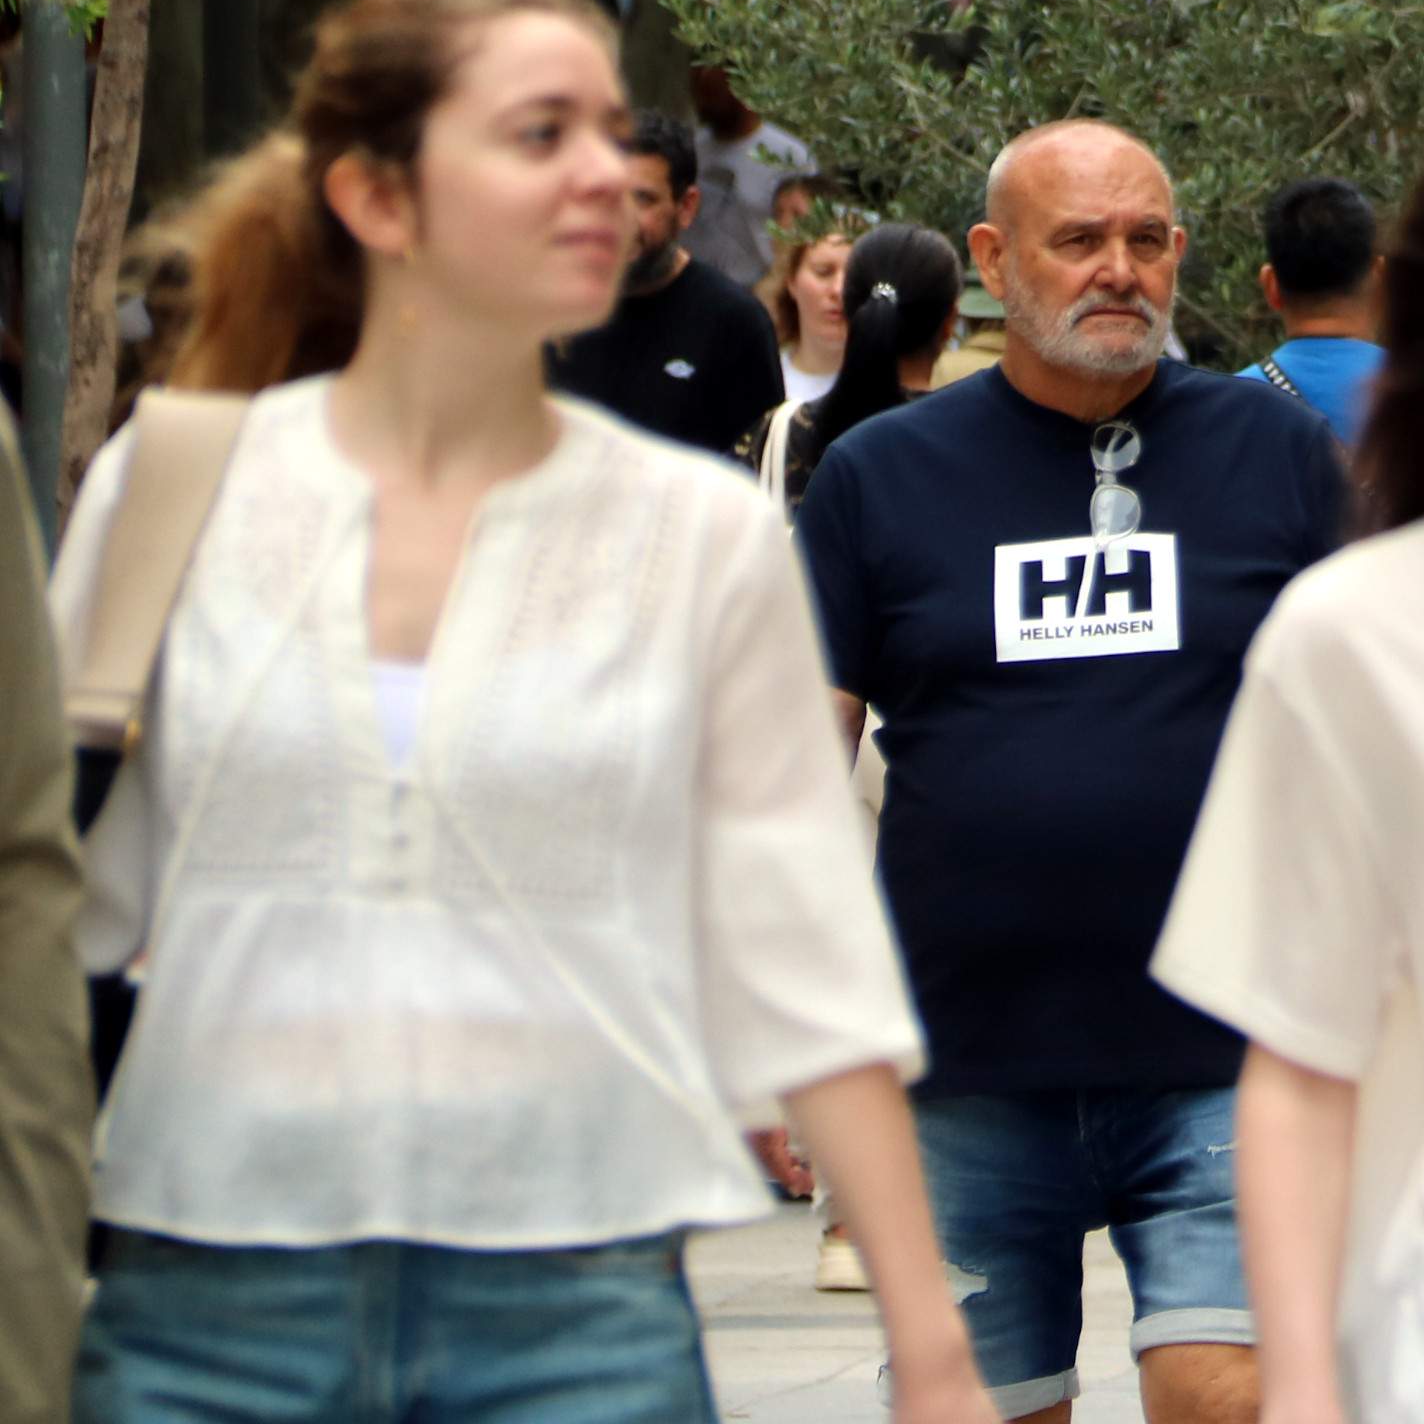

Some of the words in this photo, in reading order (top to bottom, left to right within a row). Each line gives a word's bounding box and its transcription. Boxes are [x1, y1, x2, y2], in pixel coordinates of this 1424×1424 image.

[1019, 549, 1152, 620] HH
[1019, 625, 1074, 641] HELLY
[1080, 620, 1153, 637] HANSEN
